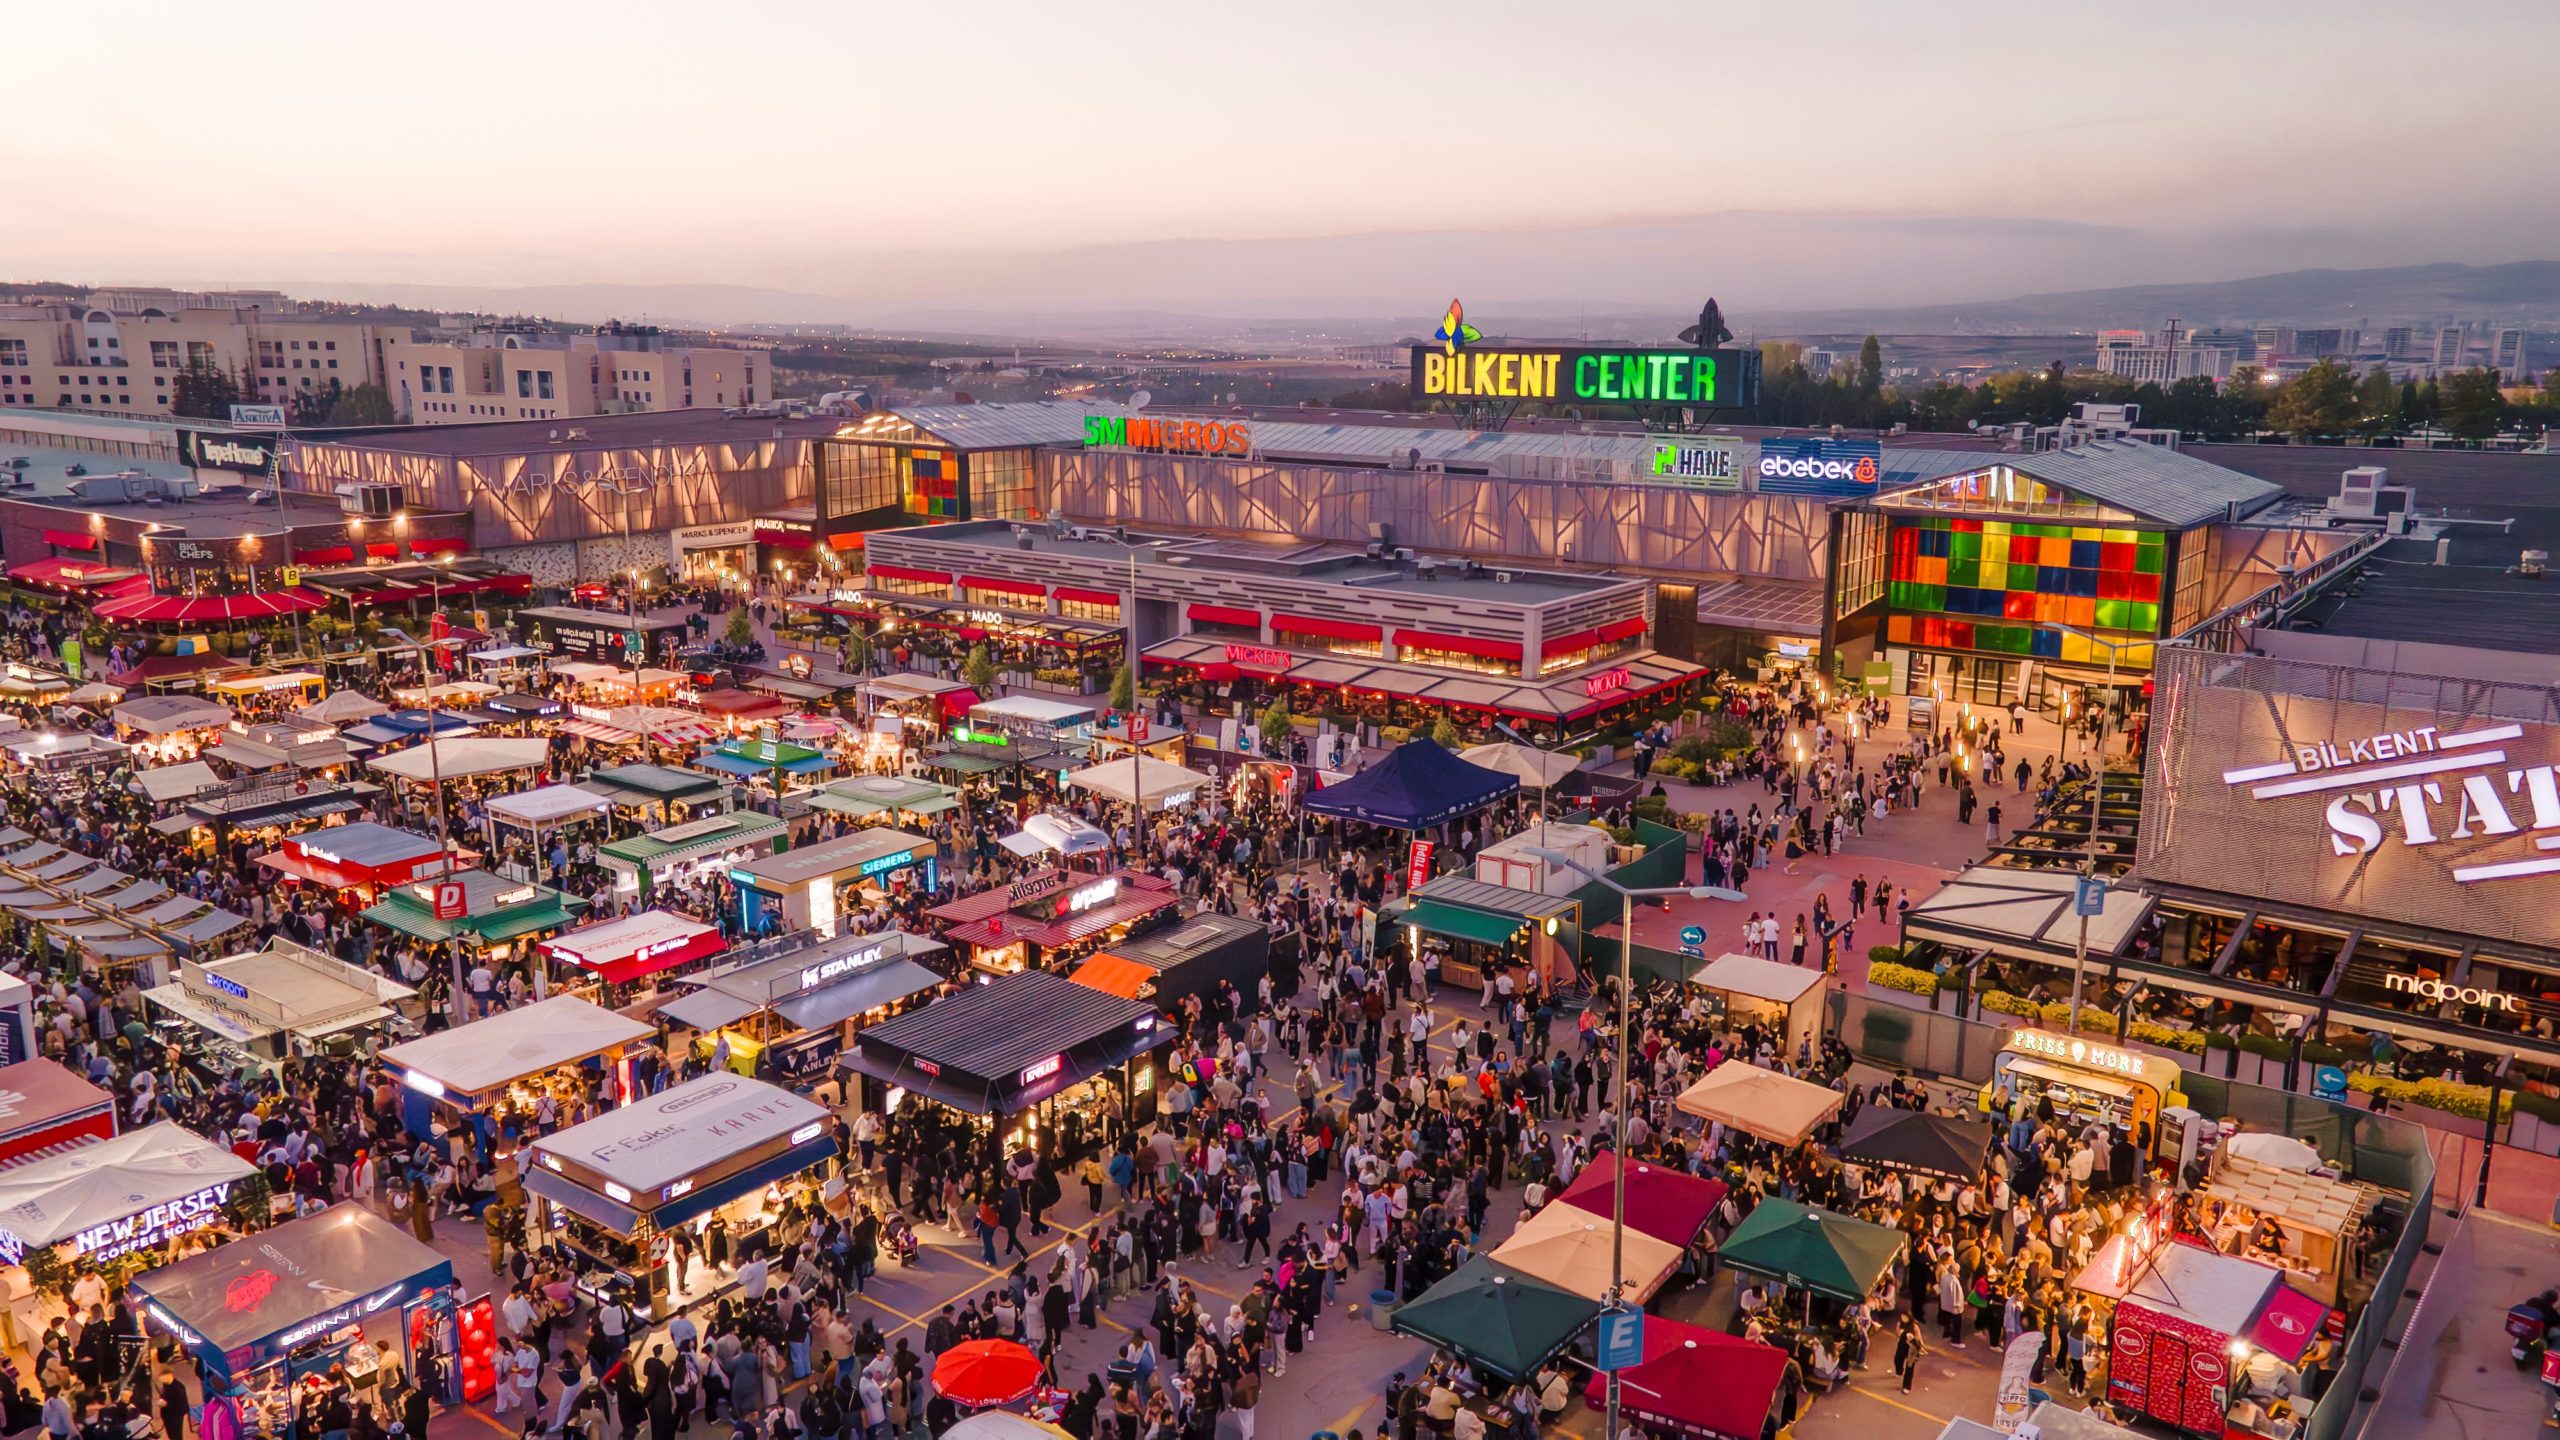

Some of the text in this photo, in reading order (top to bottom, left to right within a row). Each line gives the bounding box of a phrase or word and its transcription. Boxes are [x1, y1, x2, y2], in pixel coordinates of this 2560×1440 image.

[1574, 355, 1717, 401] CENTER
[1760, 456, 1854, 480] ebebek
[488, 464, 697, 497] MARKS & SPENCER
[682, 526, 748, 539] MARKS & SPENCER
[179, 543, 197, 552] BIG
[288, 571, 297, 580] B
[835, 590, 862, 603] MADO
[971, 610, 1002, 625] MADO
[626, 633, 635, 645] C
[1226, 644, 1292, 668] MICKEY'S
[1587, 668, 1631, 697] MICKEY'S
[1133, 716, 1145, 732] D
[862, 850, 912, 874] SIEMENS
[441, 886, 460, 907] D
[2084, 885, 2101, 905] E
[2385, 973, 2519, 1012] midpoint
[2014, 1032, 2143, 1075] FRIES MORE
[75, 1183, 231, 1254] NEW JERSEY
[97, 1213, 215, 1262] COFFEE HOUSE
[1609, 1314, 1637, 1349] E
